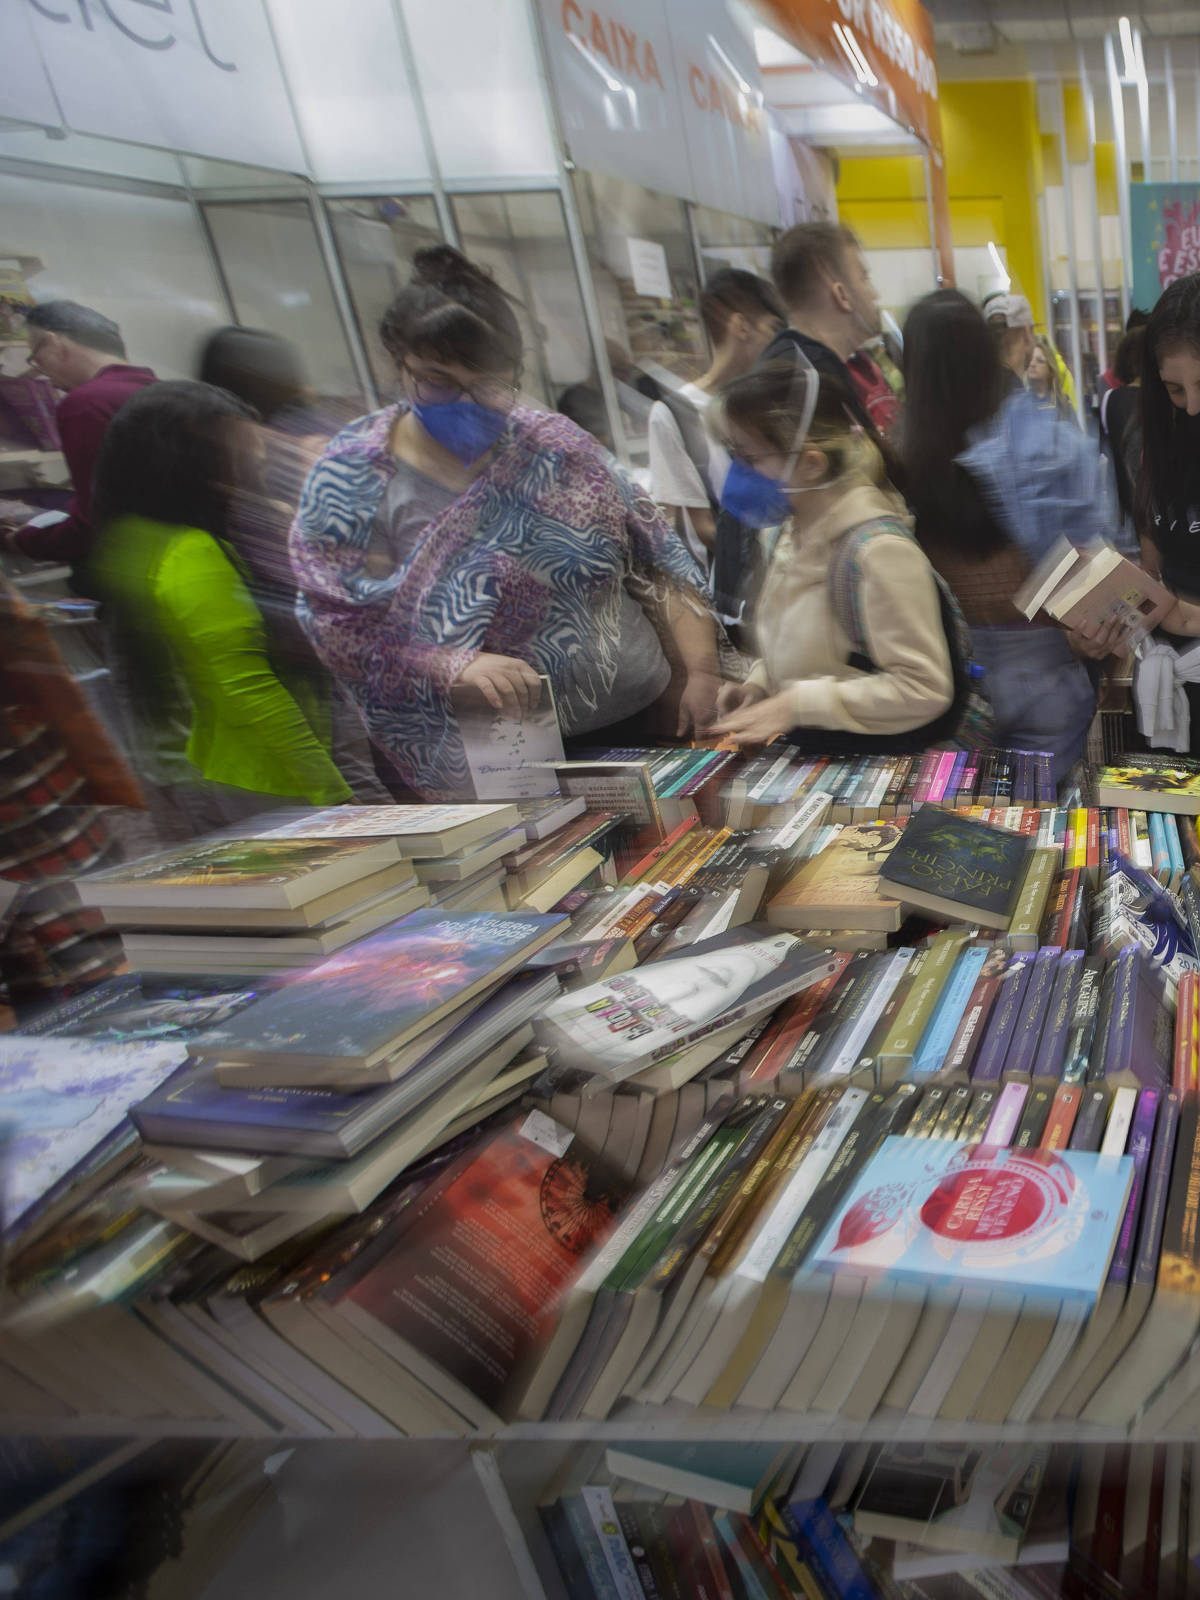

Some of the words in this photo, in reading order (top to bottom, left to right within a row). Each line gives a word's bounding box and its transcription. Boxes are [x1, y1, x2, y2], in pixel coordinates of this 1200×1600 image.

[562, 0, 665, 91] CAIXA
[483, 919, 539, 931] GUERRA
[1075, 967, 1097, 1018] APOCALIPSE
[946, 1175, 983, 1230] CARINA
[966, 1185, 987, 1222] RISSI
[1185, 1171, 1200, 1208] ROUBO
